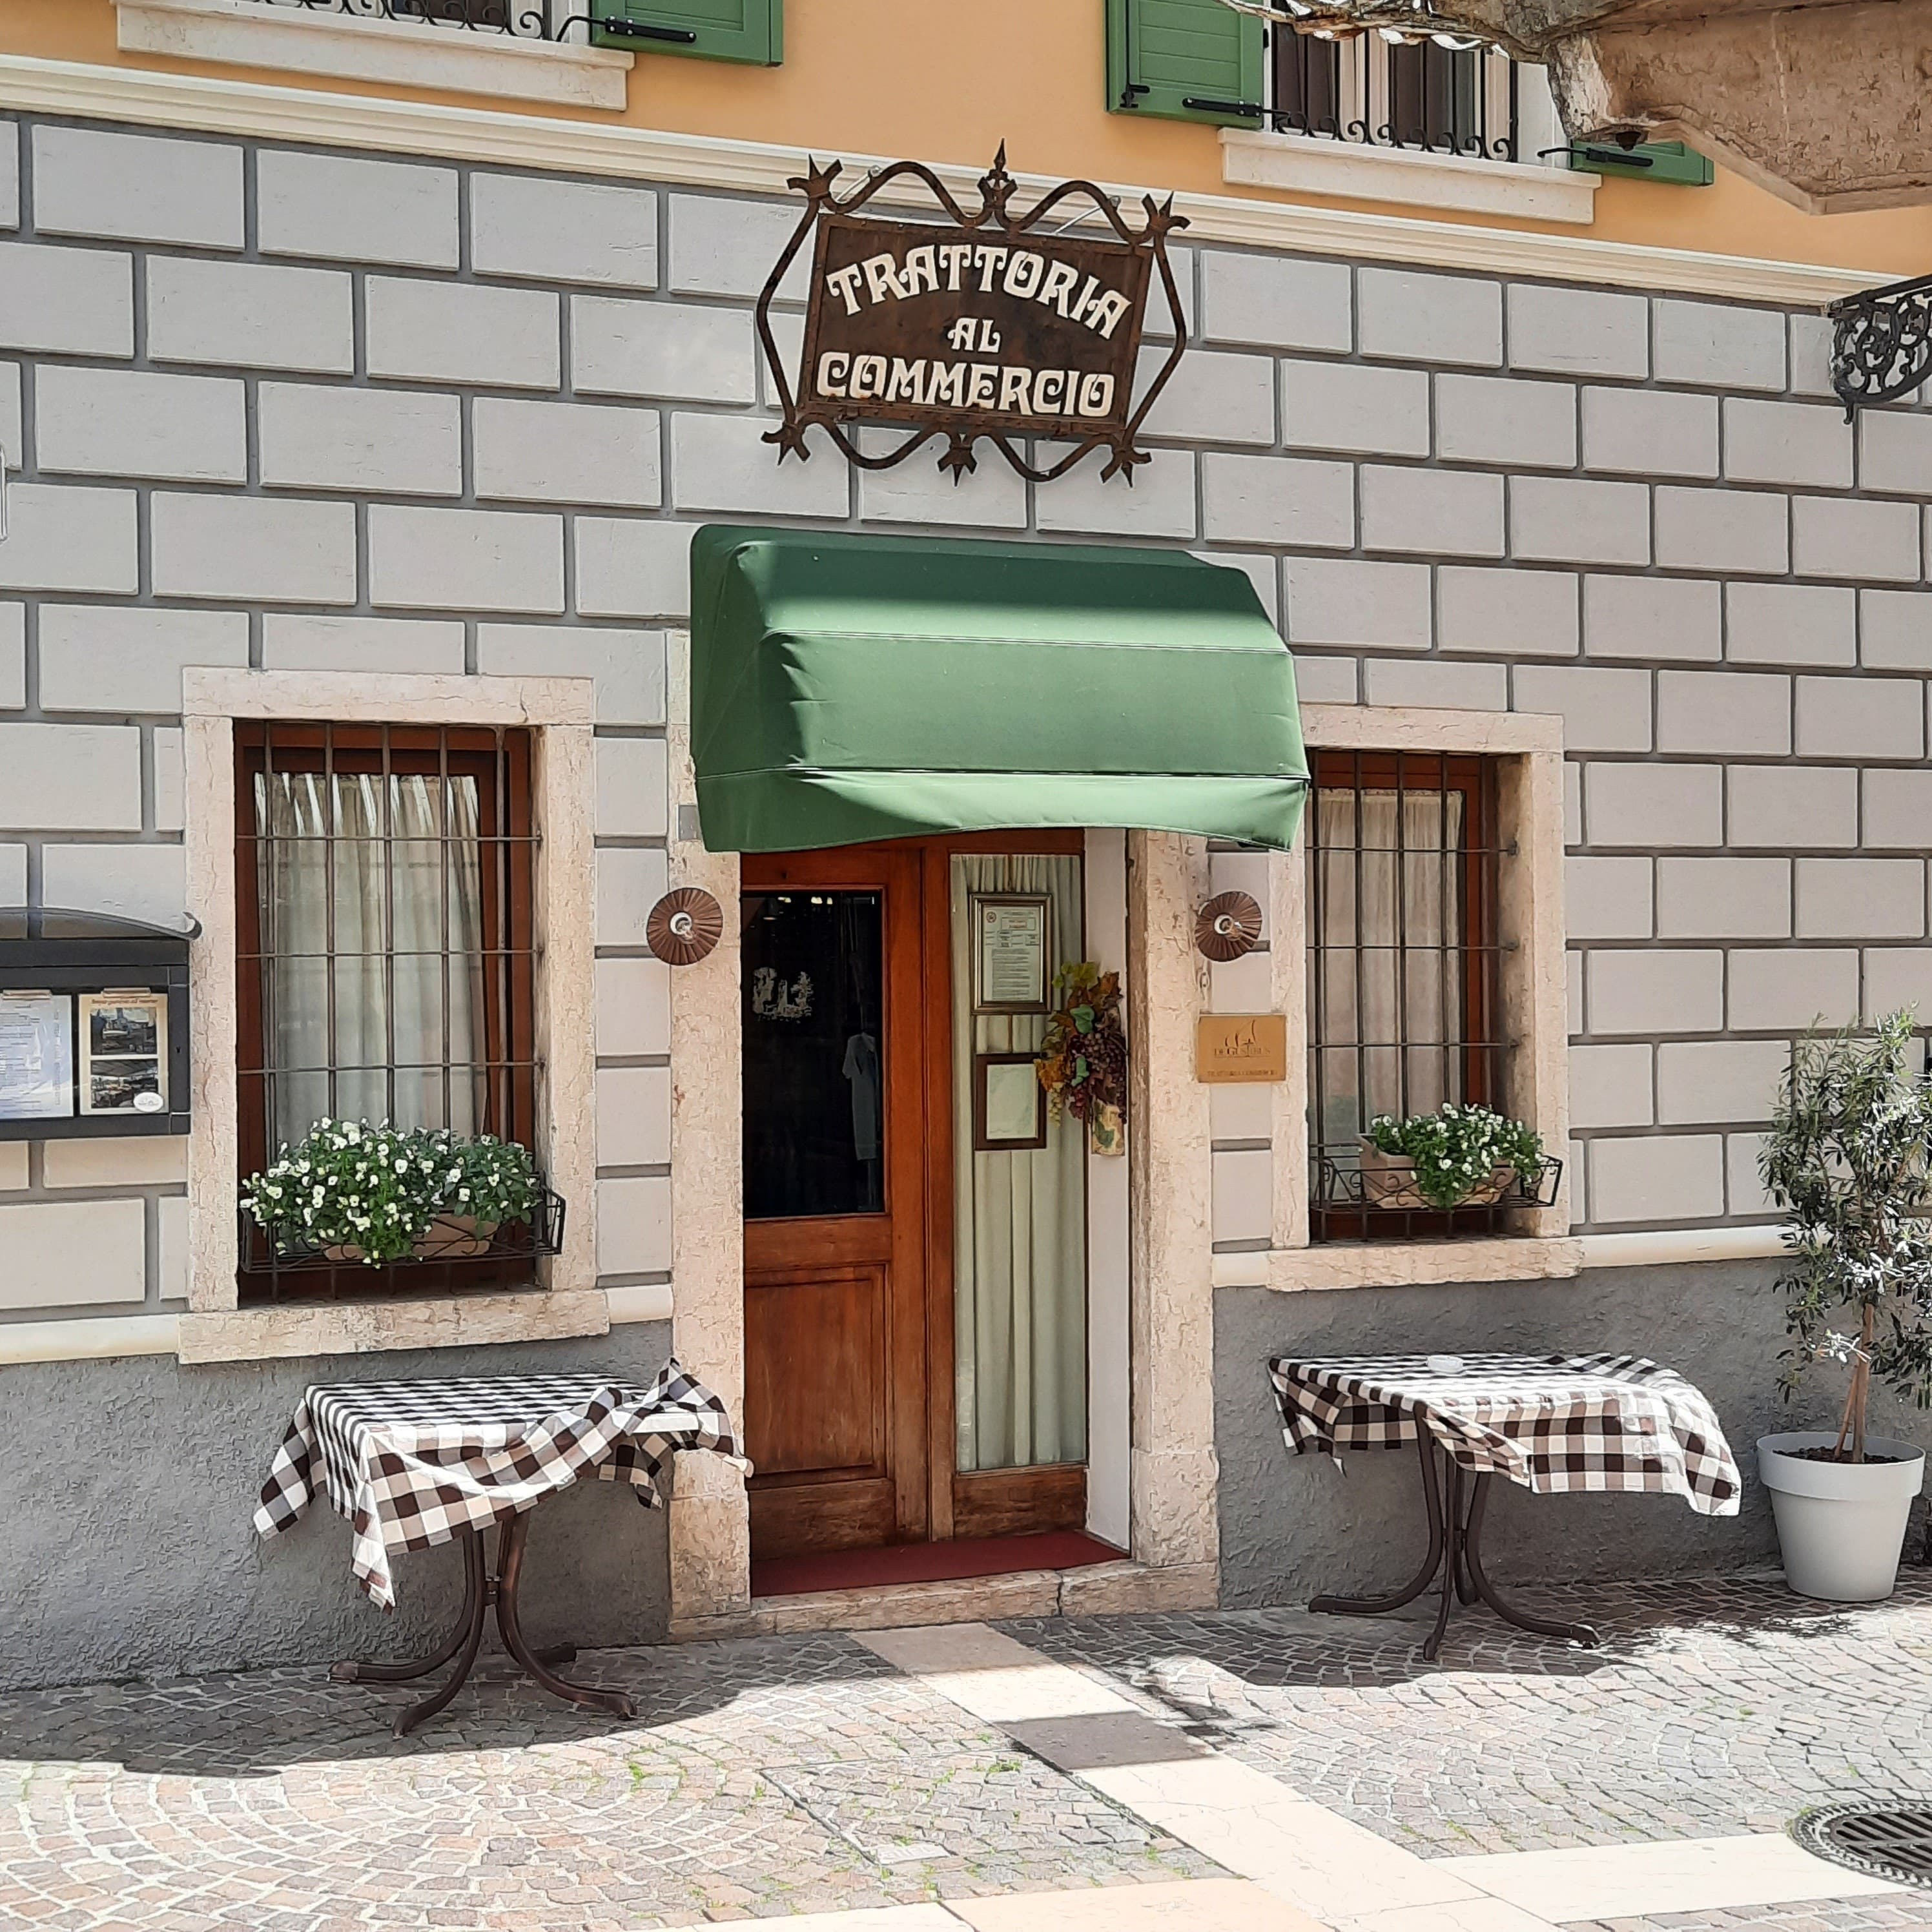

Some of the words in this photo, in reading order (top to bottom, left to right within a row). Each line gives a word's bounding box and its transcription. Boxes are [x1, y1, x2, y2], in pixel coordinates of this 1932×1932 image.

[826, 244, 1132, 339] TRATTORIA
[947, 318, 1000, 353] AL
[816, 351, 1115, 416] COMMERCIO
